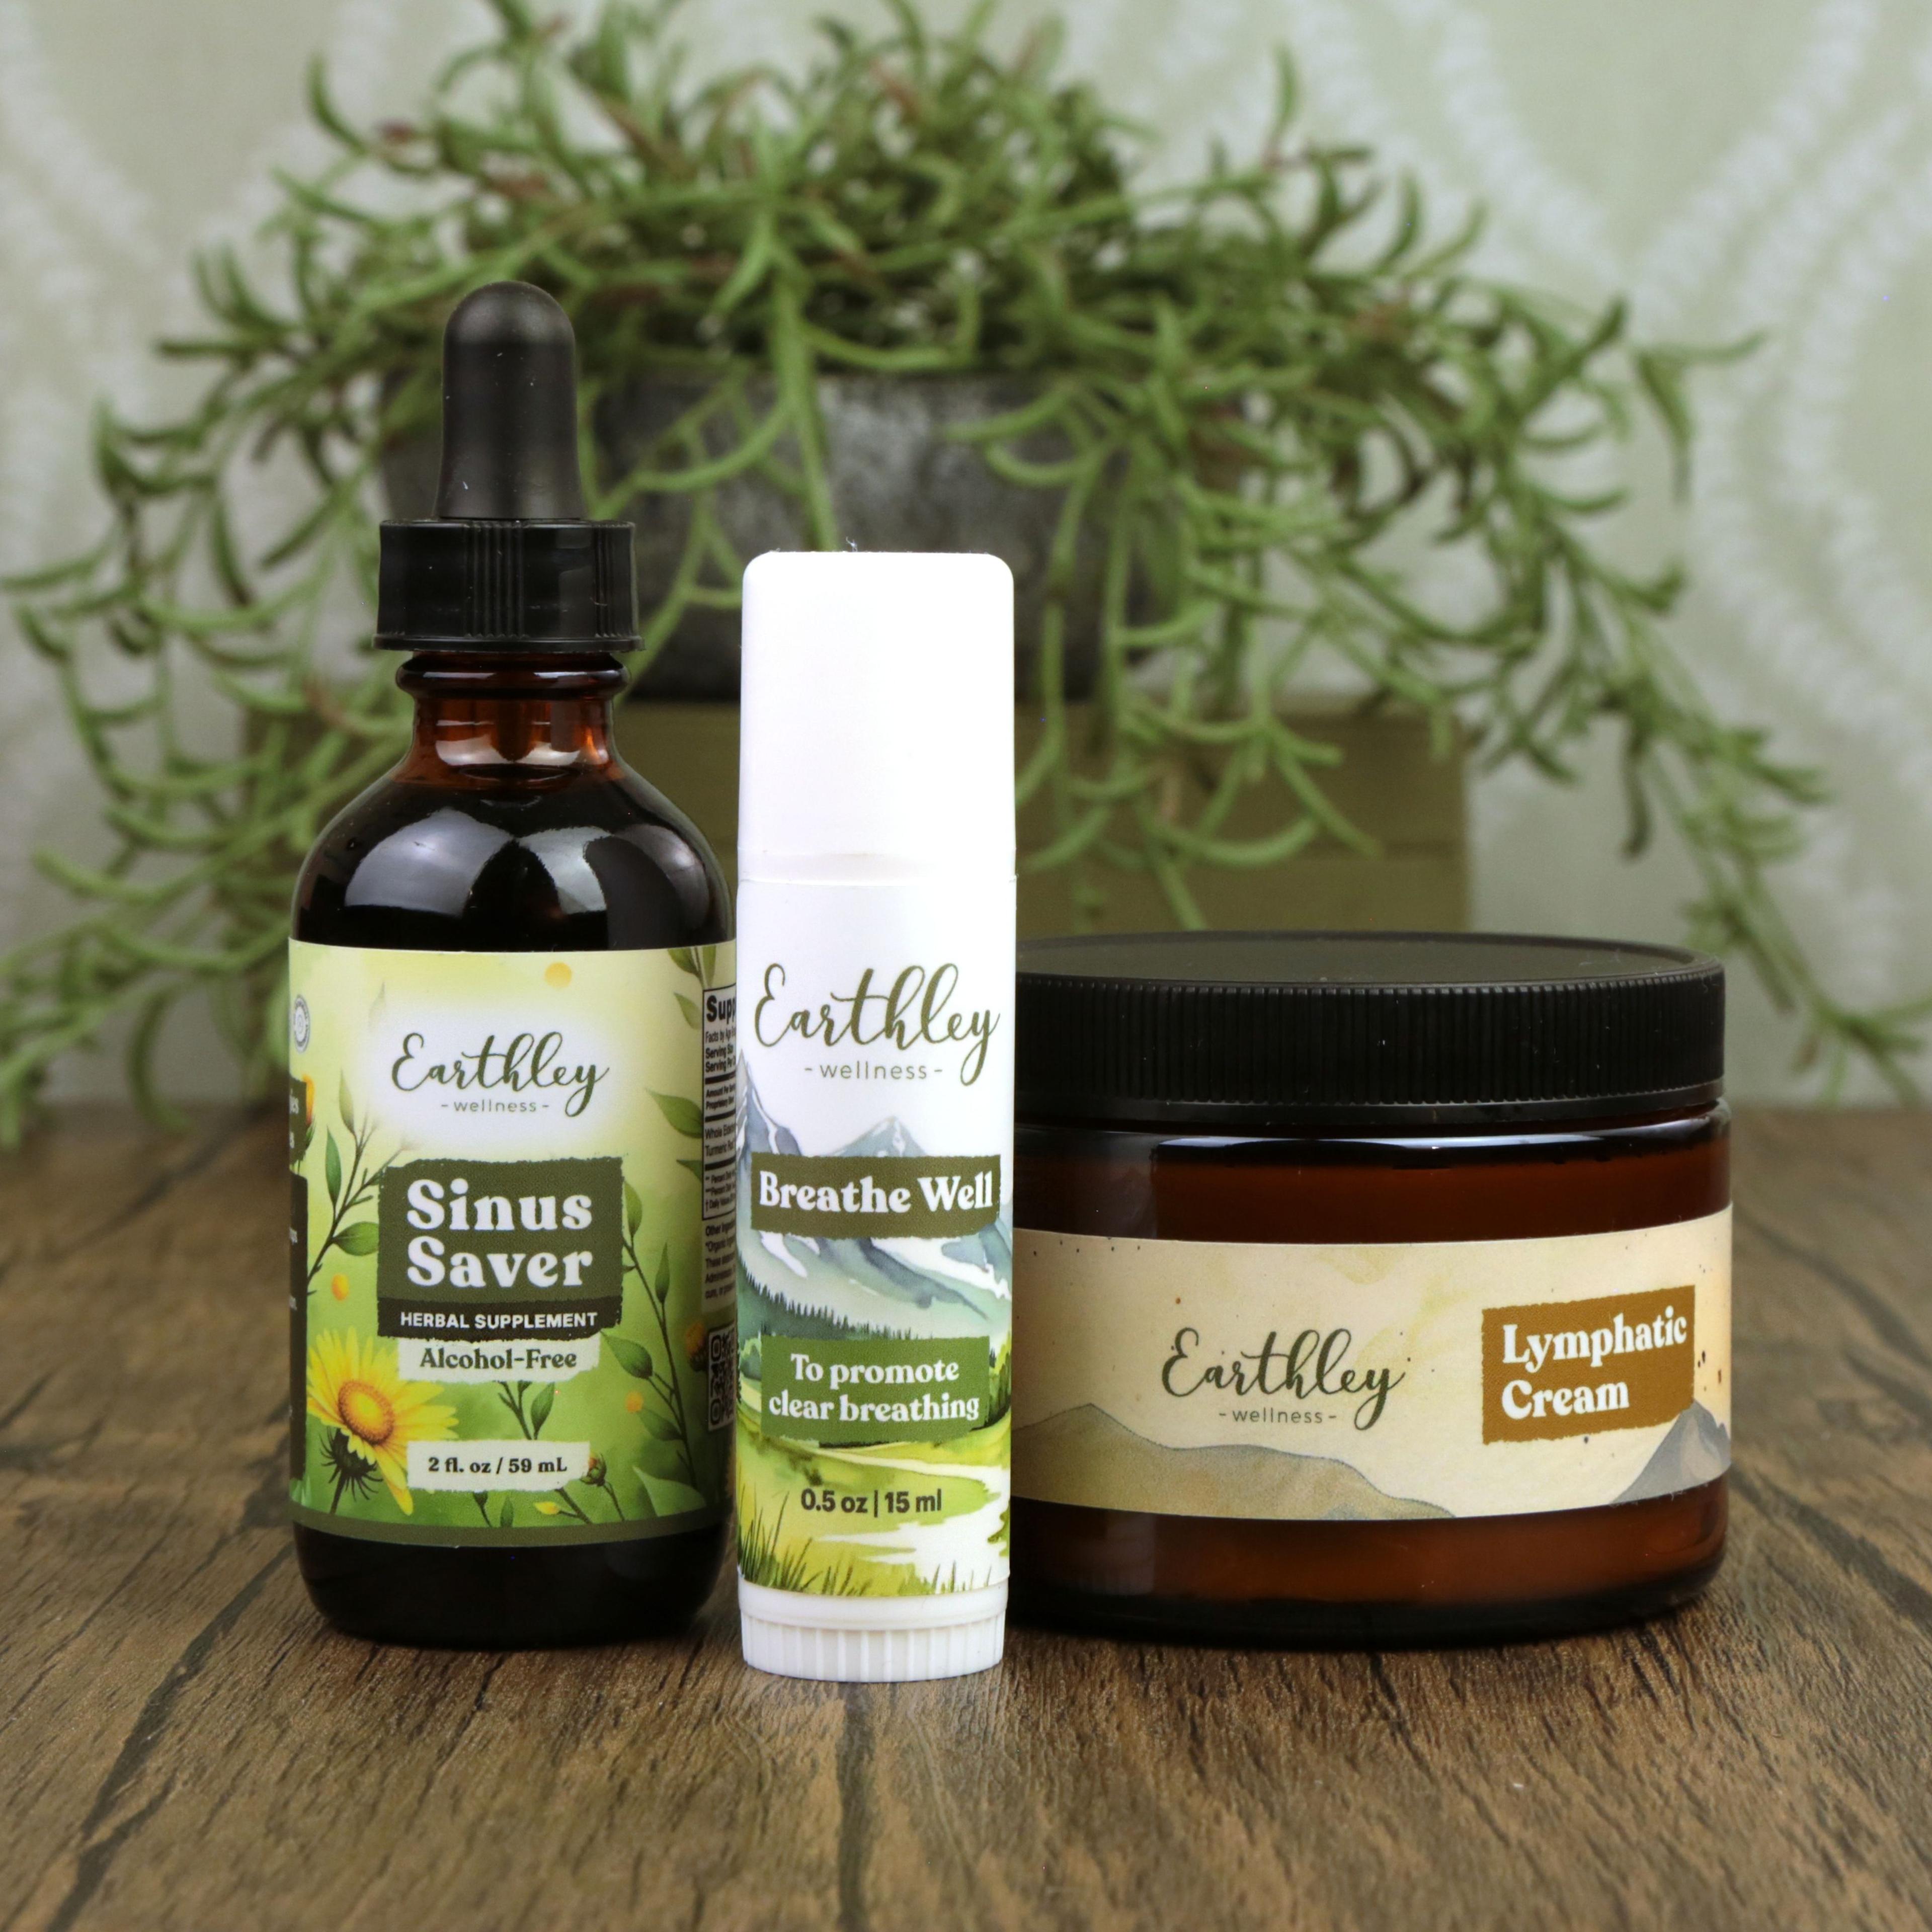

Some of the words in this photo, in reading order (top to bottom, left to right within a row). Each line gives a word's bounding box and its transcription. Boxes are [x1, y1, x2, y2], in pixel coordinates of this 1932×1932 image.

[755, 963, 1000, 1086] Earthley
[392, 1031, 609, 1117] Earthley
[408, 1178, 592, 1230] Sinus
[760, 1171, 911, 1213] Breathe
[918, 1171, 992, 1212] Well
[408, 1236, 592, 1287] Saver
[401, 1312, 469, 1328] HERBAL
[475, 1312, 597, 1329] SUPPLEMENT
[1502, 1306, 1686, 1373] Lymphatic
[420, 1347, 577, 1369] Alcohol-Free
[791, 1353, 824, 1381] To
[830, 1359, 959, 1390] promote
[1162, 1327, 1405, 1430] Earthley
[769, 1389, 835, 1420] clear
[840, 1392, 979, 1421] breathing
[1502, 1380, 1629, 1419] Cream
[429, 1457, 439, 1472] 2
[445, 1458, 464, 1473] fl.
[470, 1463, 491, 1473] oz
[509, 1459, 532, 1473] 59
[538, 1458, 567, 1472] mL
[801, 1489, 835, 1512] 0.5
[841, 1497, 867, 1513] oz
[884, 1491, 910, 1513] 15
[916, 1489, 941, 1512] ml
